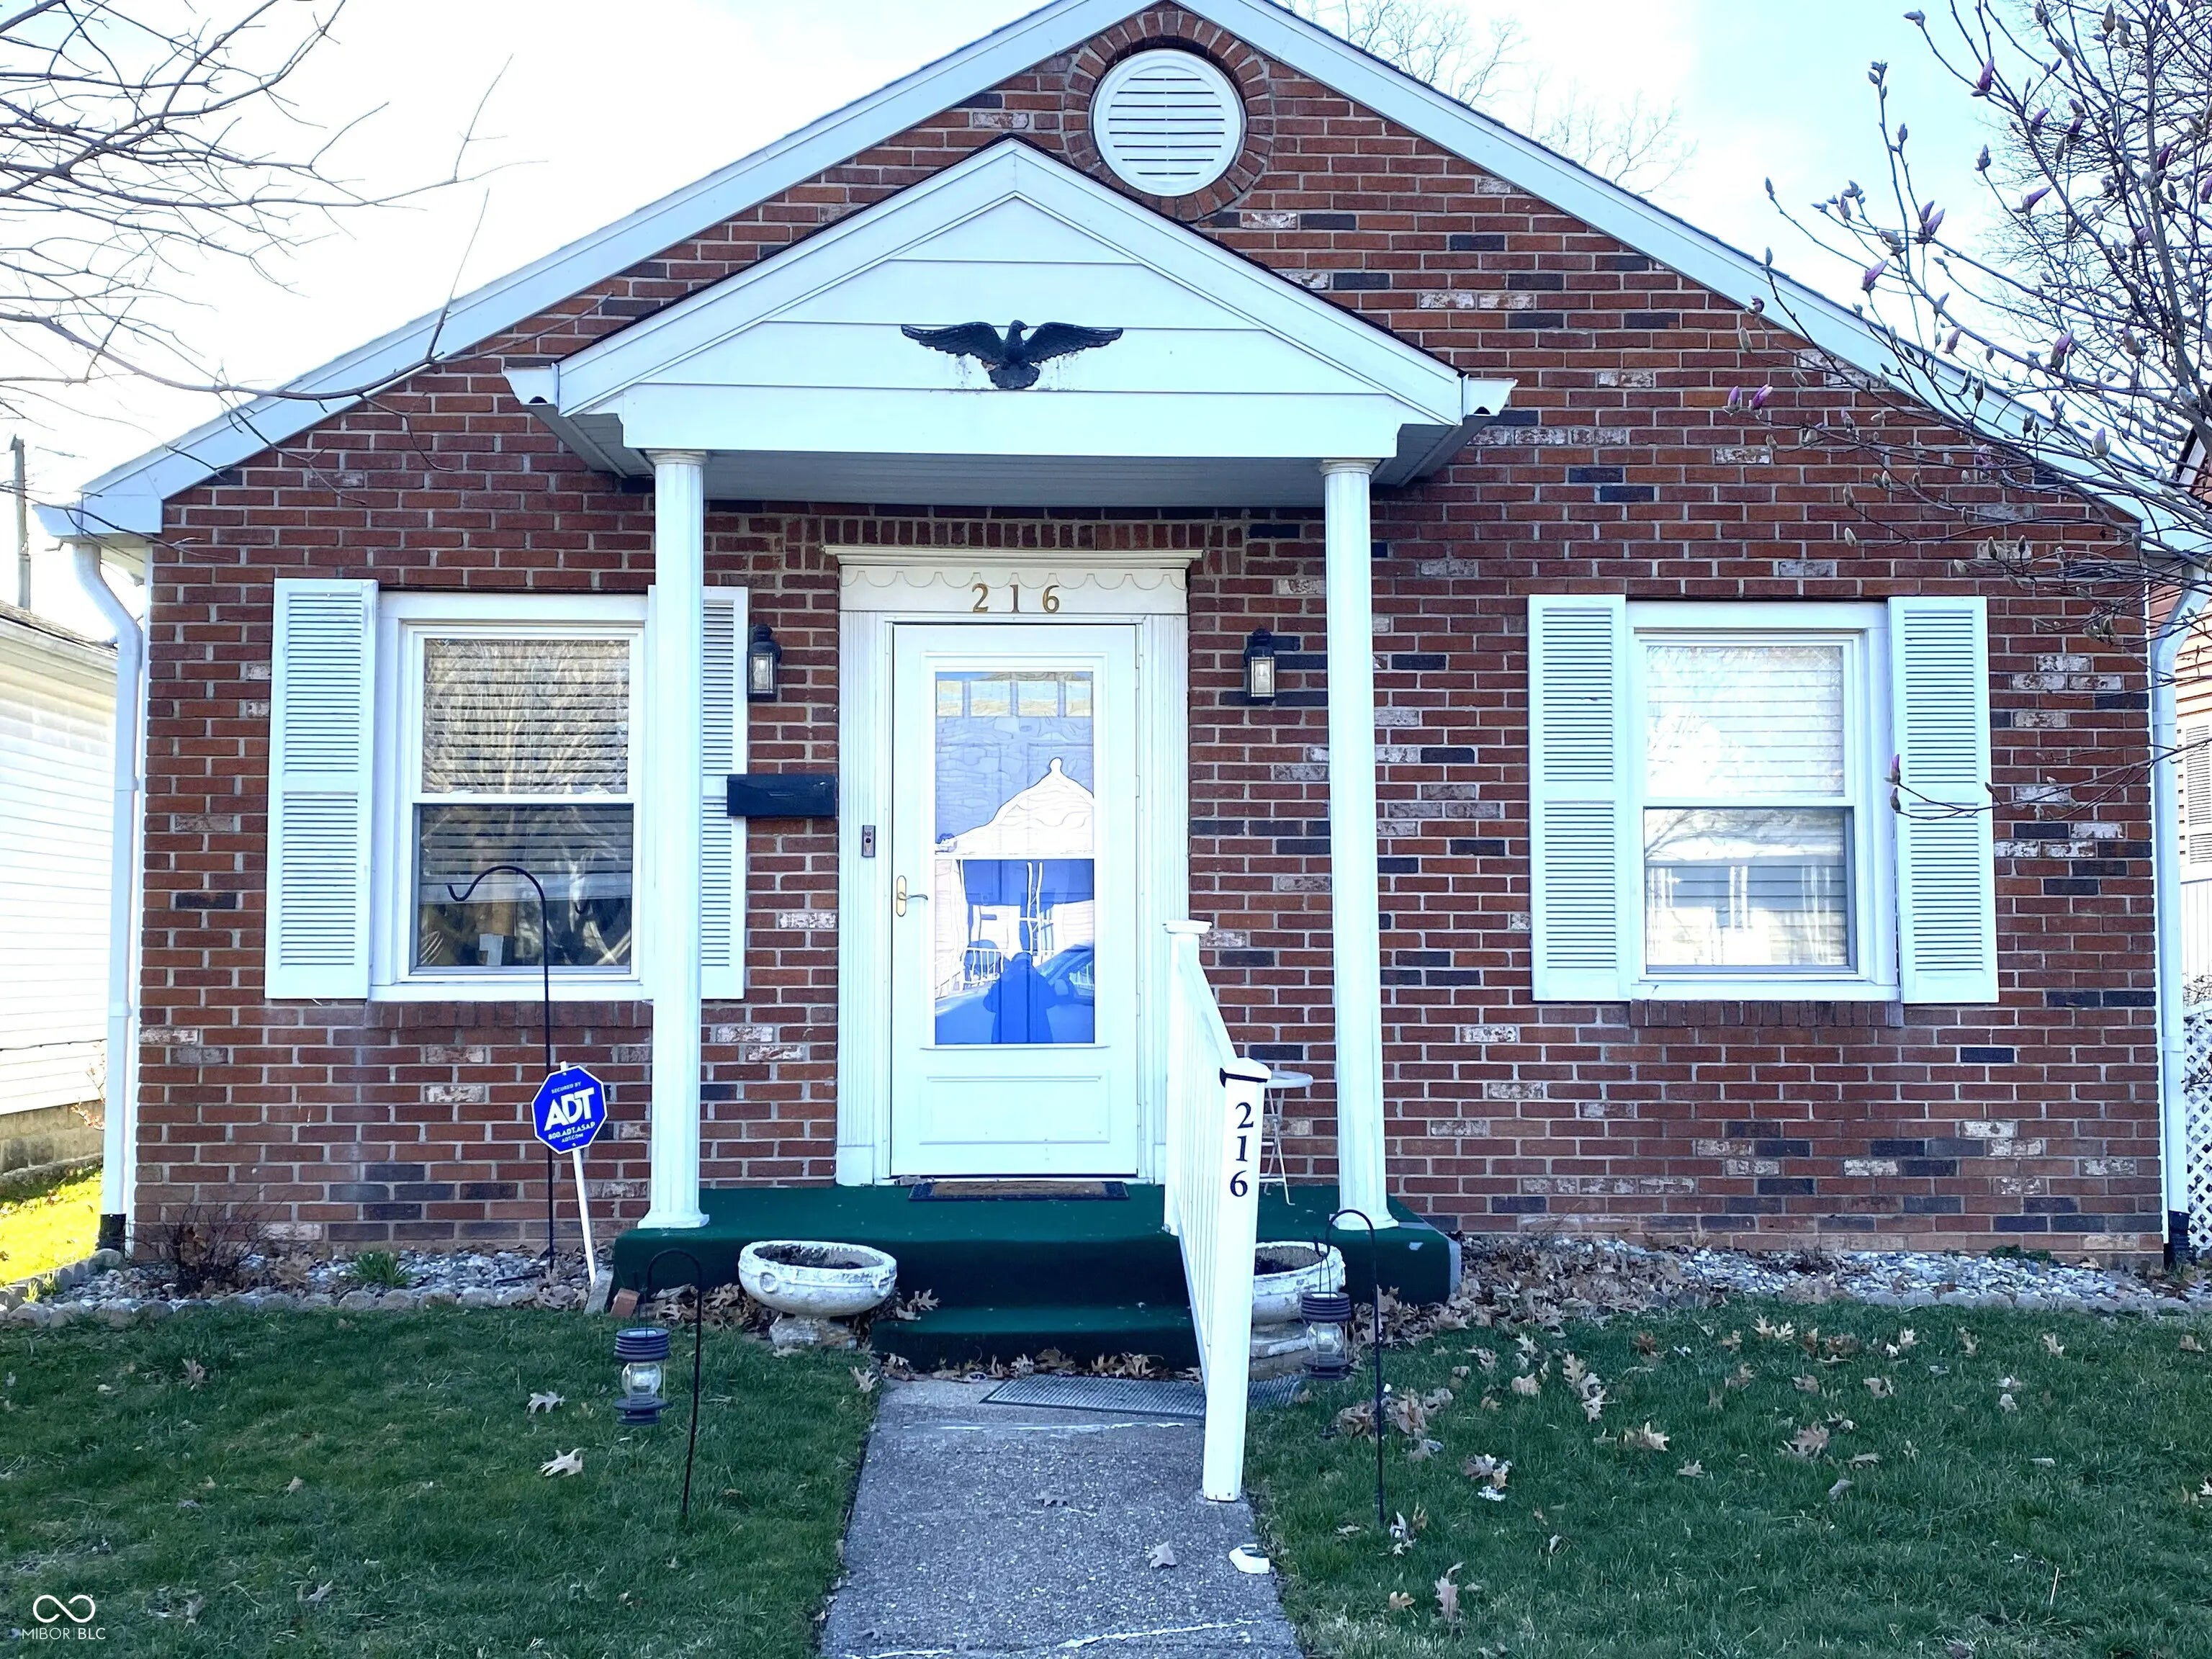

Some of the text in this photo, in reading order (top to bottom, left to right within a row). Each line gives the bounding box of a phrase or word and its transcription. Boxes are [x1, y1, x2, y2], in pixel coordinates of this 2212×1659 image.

[971, 583, 1060, 613] 216
[552, 1083, 574, 1094] SECURED
[544, 1087, 595, 1131] ADT
[1230, 1102, 1254, 1197] 216
